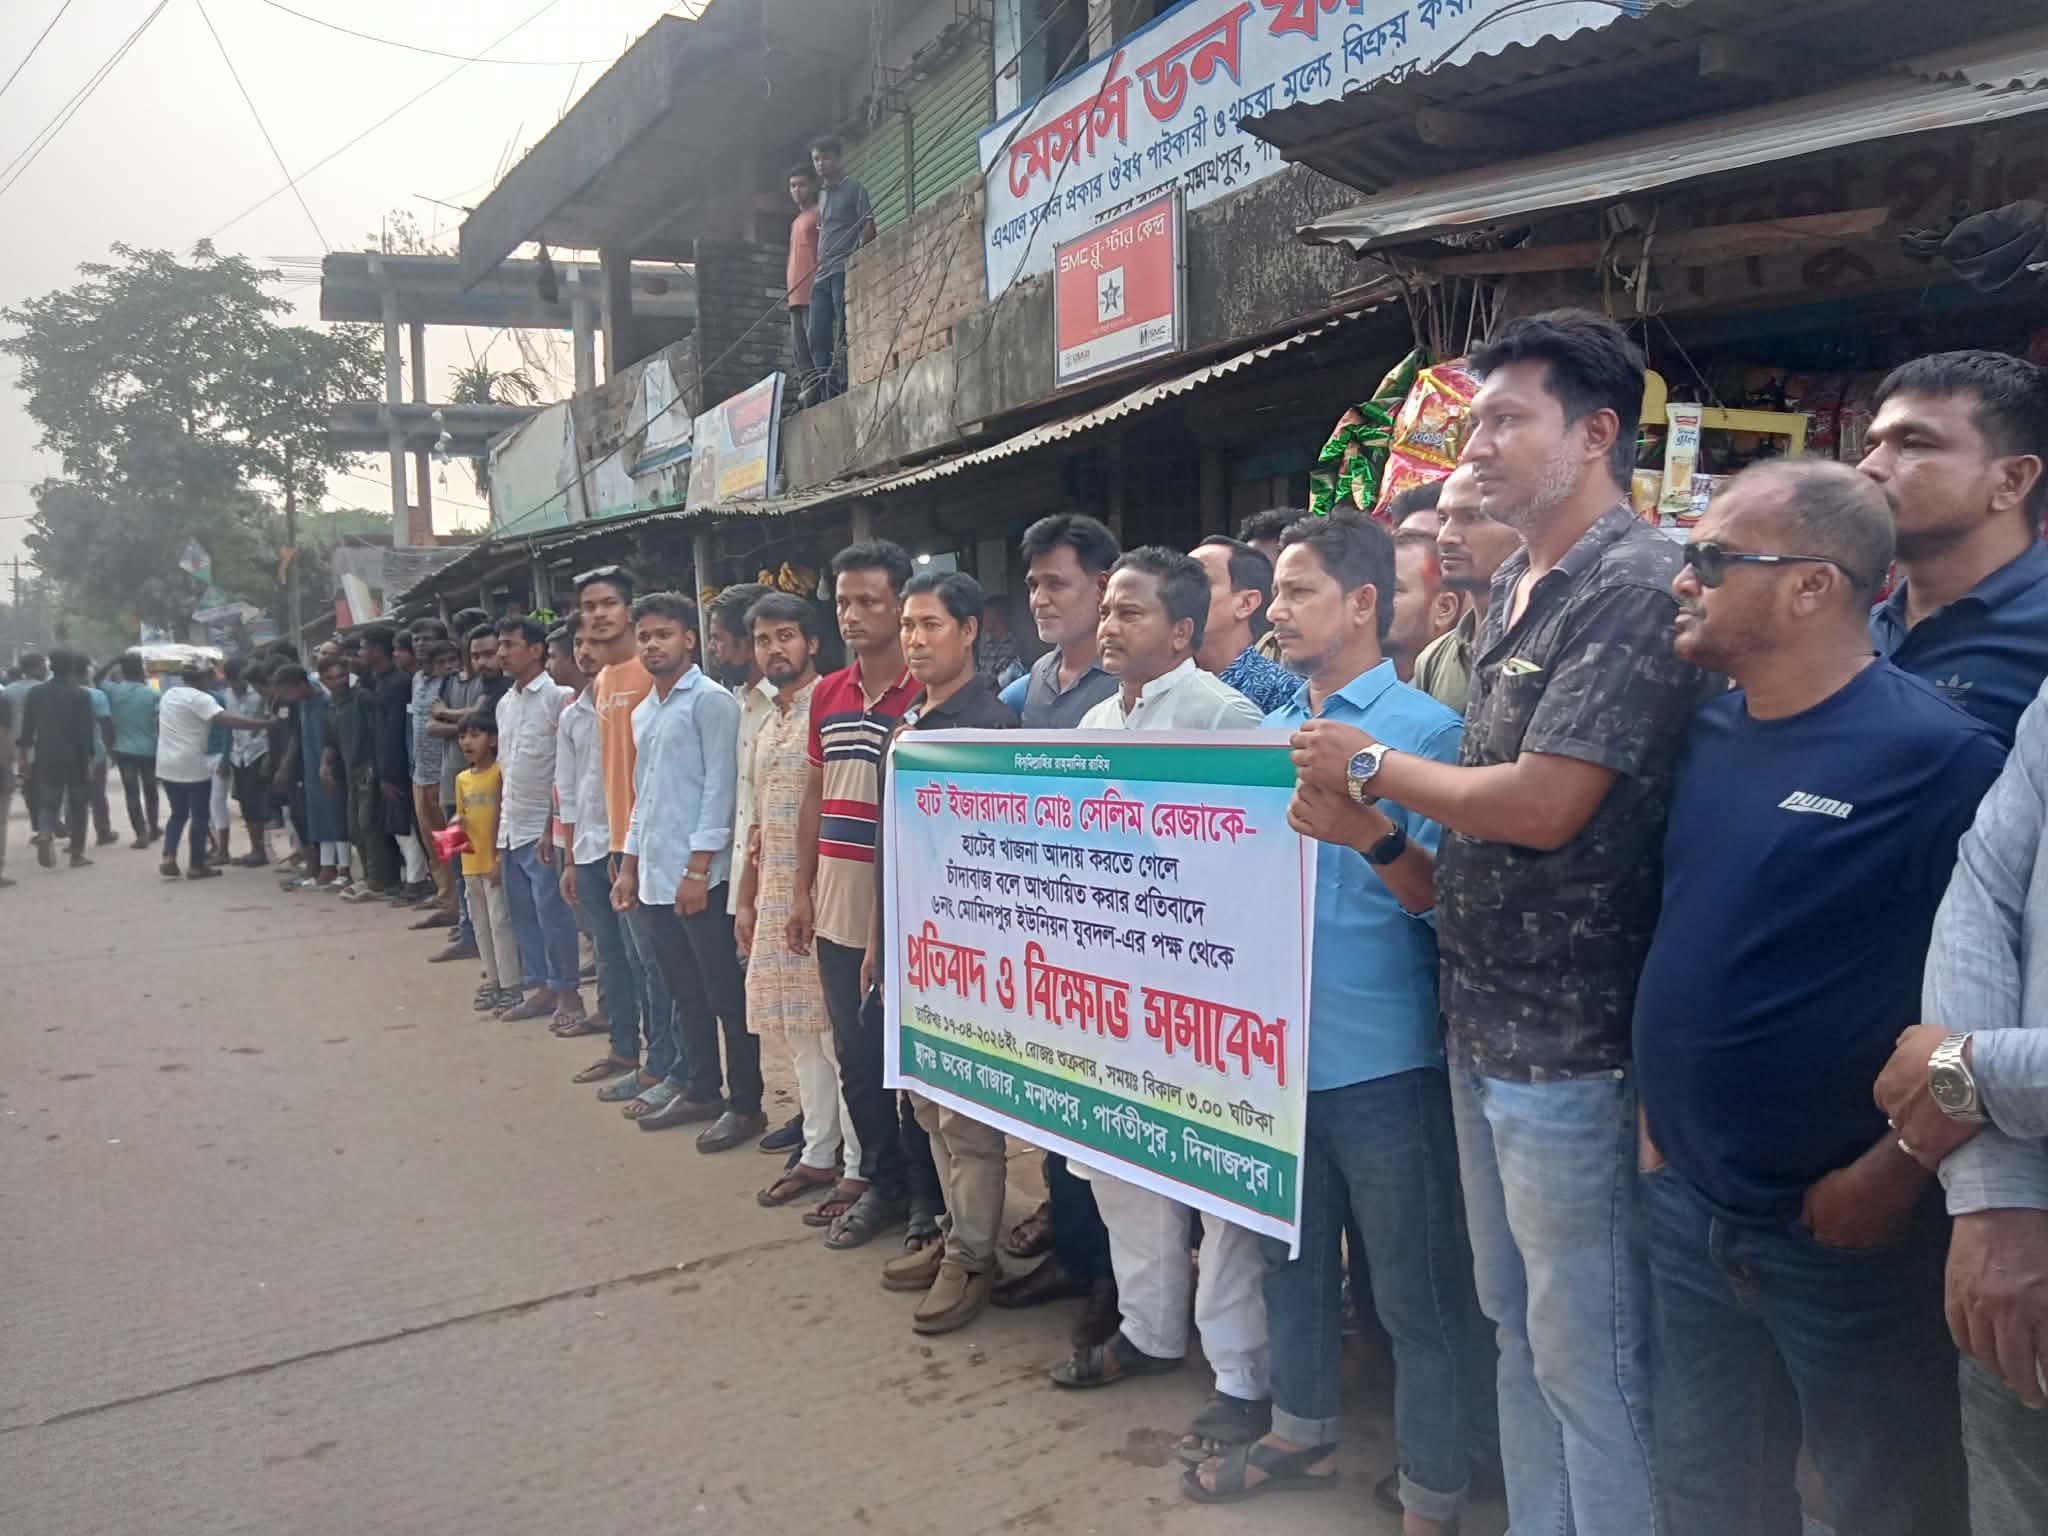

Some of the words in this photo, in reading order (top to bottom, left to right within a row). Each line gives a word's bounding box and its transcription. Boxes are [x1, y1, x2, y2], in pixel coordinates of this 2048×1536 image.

[991, 213, 1028, 248] এখানে
[1066, 172, 1103, 211] প্রকার
[1108, 151, 1142, 191] ঔষধ
[1146, 106, 1208, 170] পাইকারী
[1213, 110, 1226, 138] ও
[1342, 10, 1410, 73] বিক্রয়
[1008, 50, 1133, 199] মেসার্স
[1135, 2, 1256, 122] ডন
[915, 781, 943, 817] হাট
[946, 781, 1029, 825] ইজারাদার
[1034, 794, 1073, 829] মোঃ
[1079, 787, 1145, 834] সেলিম
[1777, 790, 1855, 819] PUMA
[961, 828, 996, 858] হাটের
[1000, 836, 1039, 865] খাজনা
[1042, 843, 1085, 870] আদায়
[1088, 848, 1134, 874] করতে
[1138, 853, 1180, 882] গেলে
[946, 858, 992, 892] চাঁদাবাজ
[995, 871, 1021, 897] বলে
[1024, 873, 1087, 905] আখ্যায়িত
[1089, 886, 1130, 913] করার
[1134, 886, 1207, 926] প্রতিবাদে
[958, 896, 1012, 932] মোমিনপুর
[1015, 902, 1069, 941] ইউনিয়ন
[1071, 919, 1147, 955] যুবদল-এর
[1151, 931, 1184, 961] পক্ষ
[1188, 939, 1236, 971] থেকে
[907, 920, 986, 1003] প্রতিবাদ
[996, 956, 1015, 1010] ও
[1024, 940, 1130, 1039] বিক্ষোভ
[1140, 986, 1287, 1087] সমাবেশ
[939, 1050, 973, 1084] ভবের
[1025, 1041, 1054, 1064] রোজঃ
[1104, 1064, 1138, 1092] সময়ঃ
[1142, 1070, 1183, 1106] বিকাল
[1186, 1090, 1222, 1118] ৩.০০
[1228, 1099, 1276, 1137] ঘটিকা
